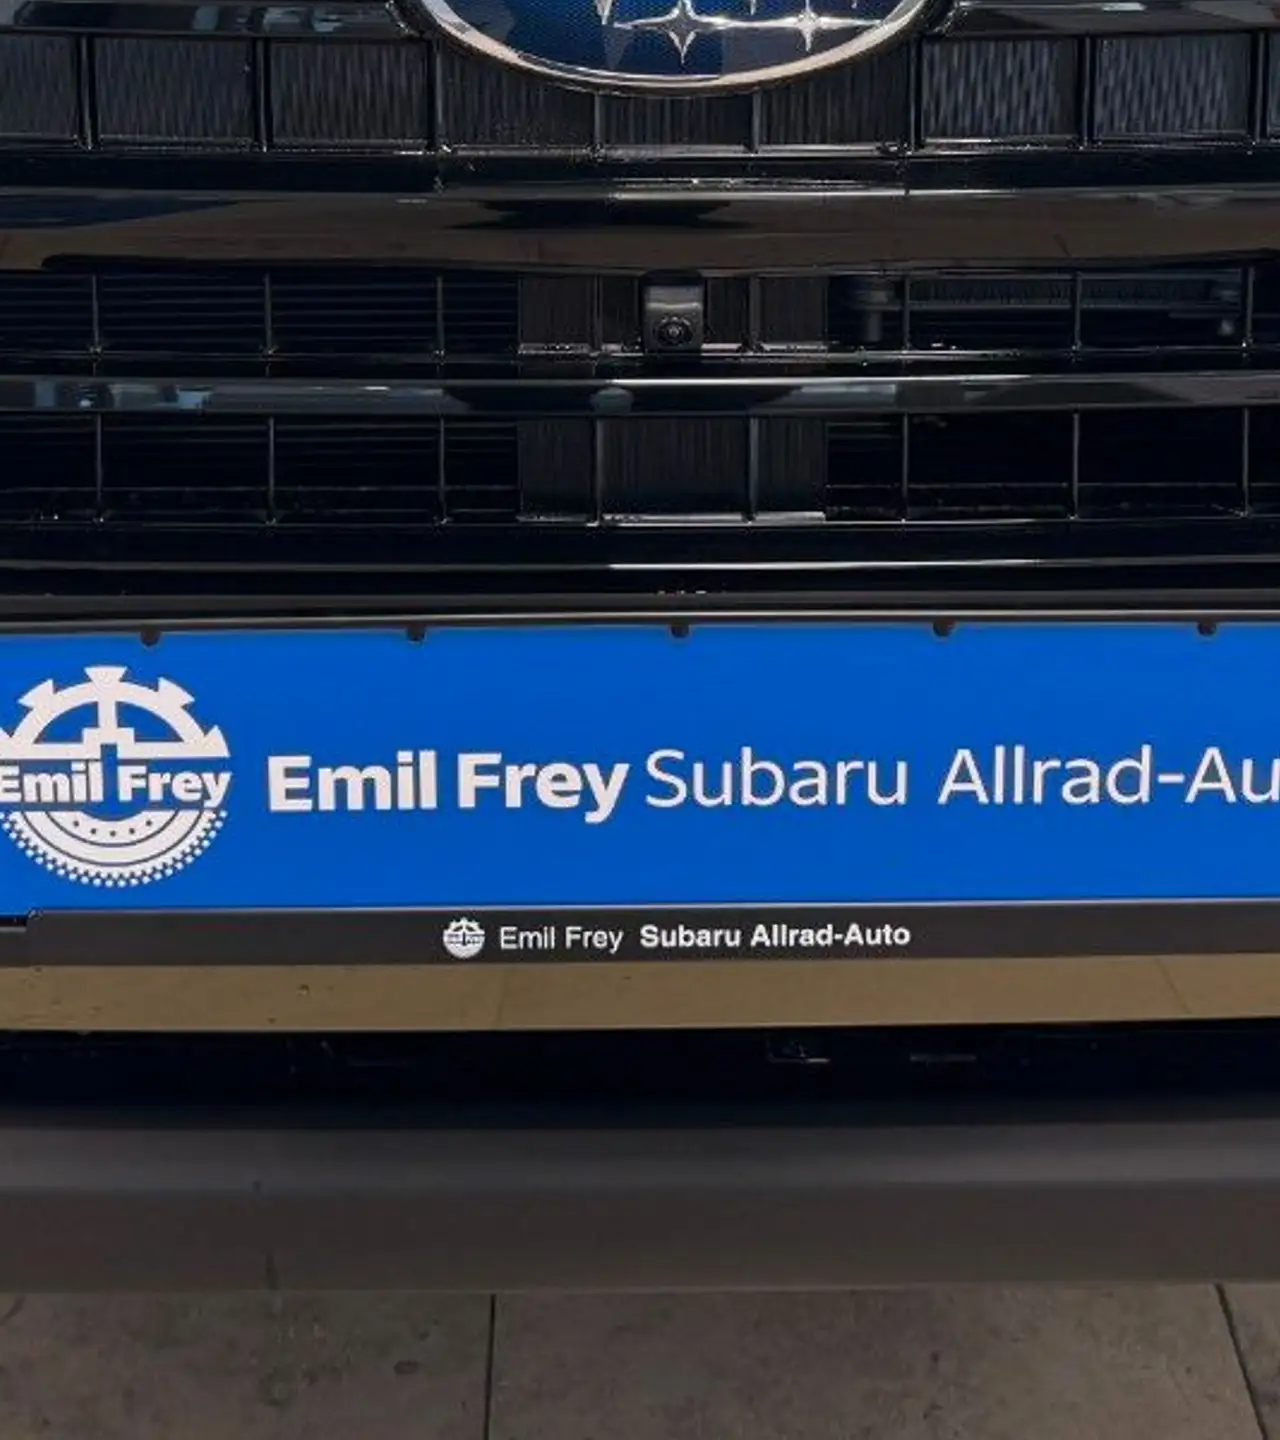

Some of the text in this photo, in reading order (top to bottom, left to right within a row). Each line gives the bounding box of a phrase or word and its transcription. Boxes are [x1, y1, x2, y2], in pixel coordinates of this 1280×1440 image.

[117, 765, 232, 809] Frey
[269, 750, 437, 811] Emil
[458, 753, 630, 823] Frey
[646, 746, 907, 808] Subaru
[500, 926, 556, 950] Emil
[565, 926, 624, 954] Frey
[639, 924, 742, 948] Subaru
[750, 922, 911, 948] Allrad-Auto
